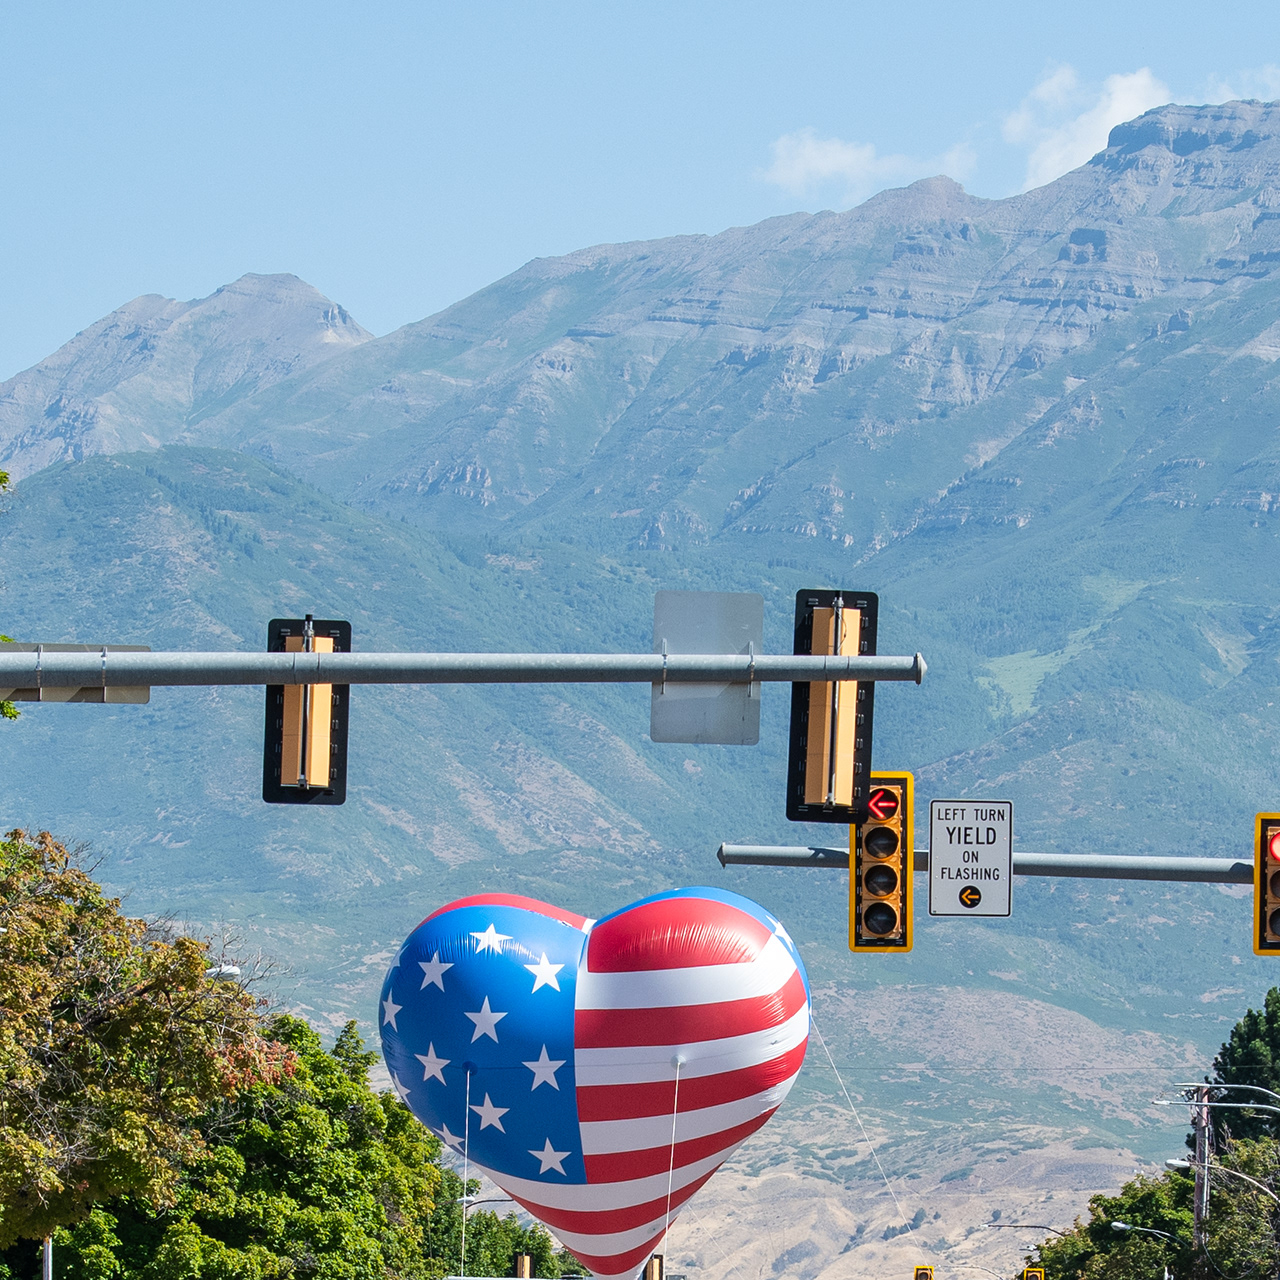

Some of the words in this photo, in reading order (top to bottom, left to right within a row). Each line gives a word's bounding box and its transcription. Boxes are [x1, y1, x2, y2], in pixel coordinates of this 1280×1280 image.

[937, 808, 966, 820] LEFT
[974, 809, 1005, 821] TURN
[946, 827, 997, 845] YIELD
[962, 851, 979, 863] ON
[941, 867, 1000, 880] FLASHING
